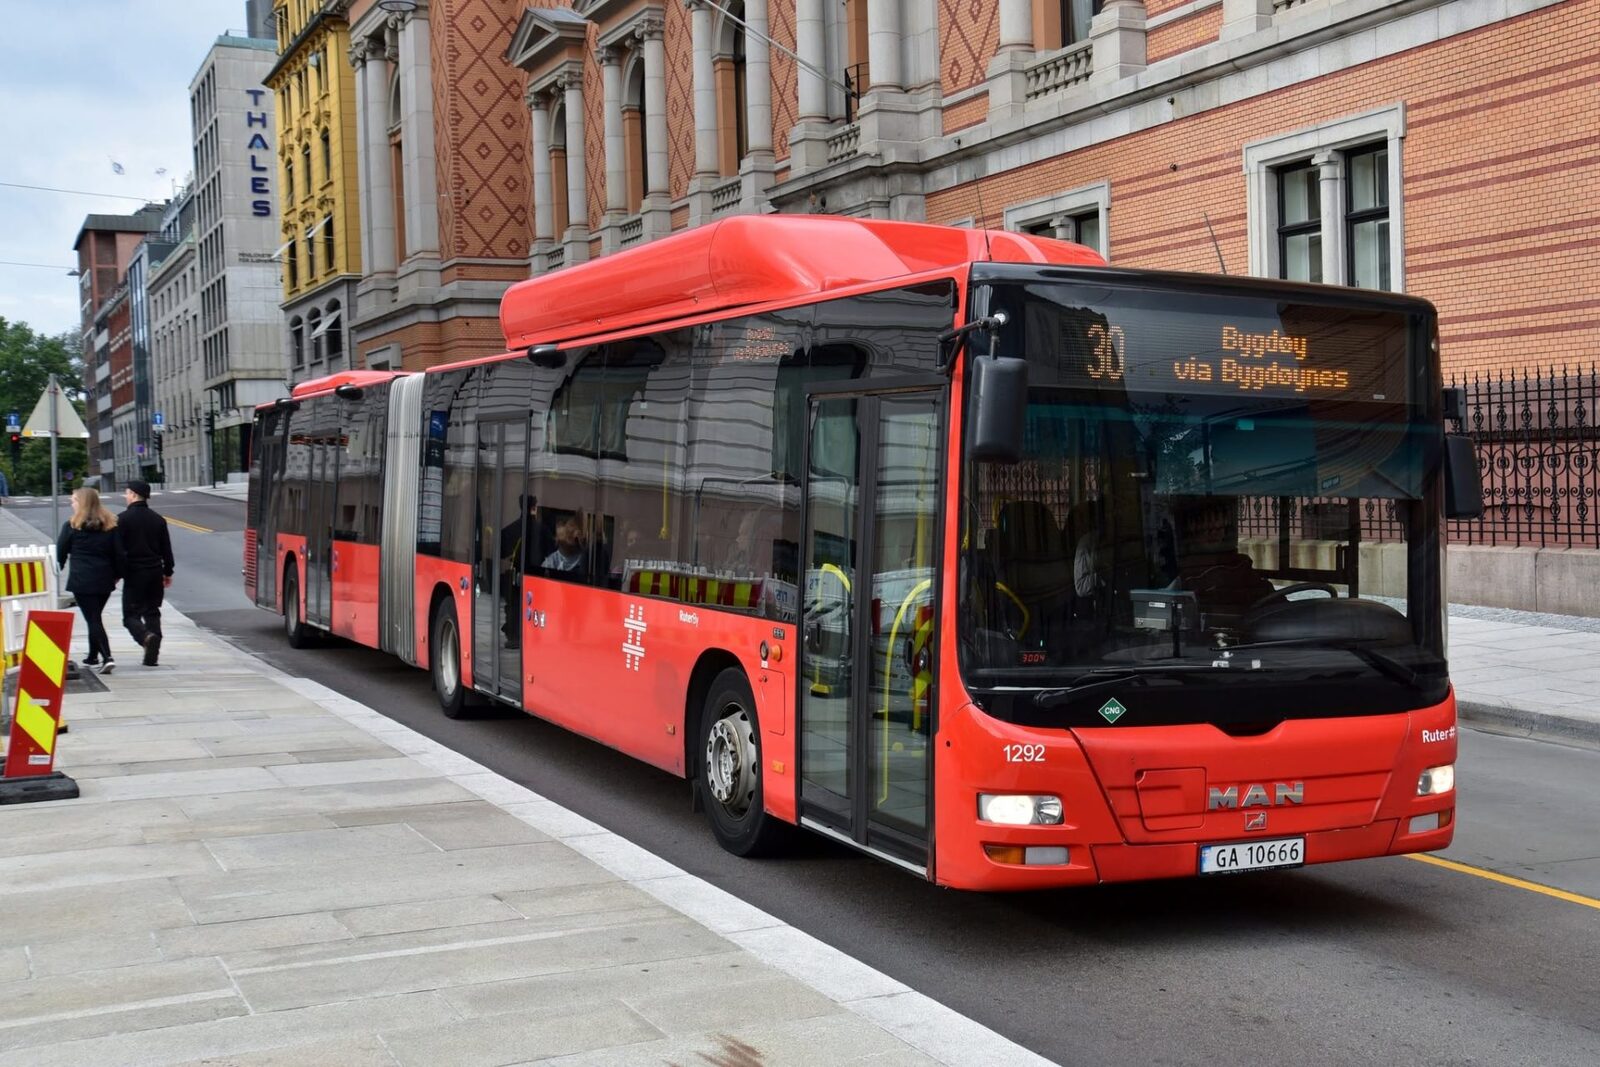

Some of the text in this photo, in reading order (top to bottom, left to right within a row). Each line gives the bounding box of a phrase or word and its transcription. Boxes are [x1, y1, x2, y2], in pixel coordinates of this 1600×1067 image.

[246, 89, 271, 217] THALES
[1087, 324, 1124, 380] 30
[1221, 326, 1307, 360] Bygdøy
[1174, 356, 1349, 392] via Bygdøynes
[1104, 706, 1120, 714] CNG
[1003, 744, 1046, 762] 1292
[1208, 782, 1304, 809] MAN
[1216, 842, 1299, 867] GA 10666
